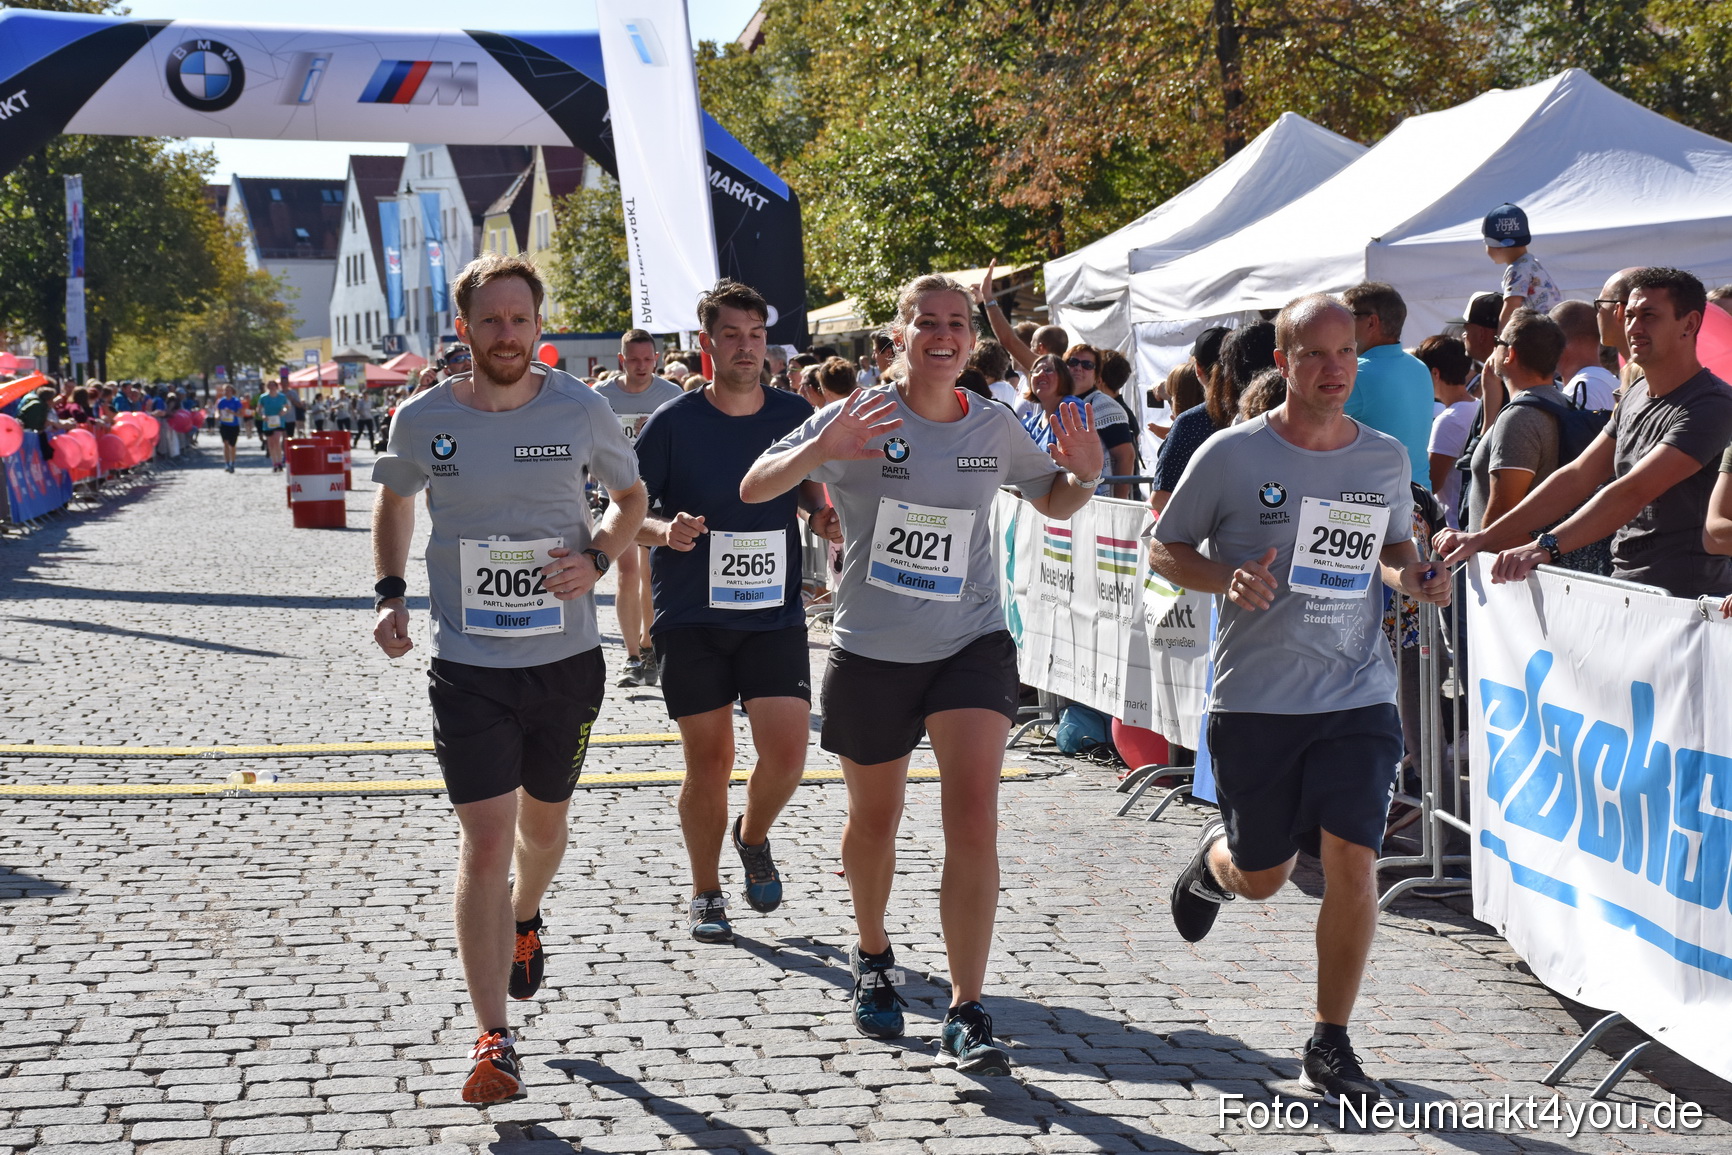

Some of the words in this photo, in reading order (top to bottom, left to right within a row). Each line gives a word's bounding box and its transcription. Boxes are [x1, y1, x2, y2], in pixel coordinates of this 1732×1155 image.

[172, 39, 238, 63] BMW
[514, 445, 571, 458] BOCK
[431, 464, 459, 472] PARTL
[957, 457, 998, 468] BOCK
[882, 465, 910, 475] PARTL
[882, 472, 910, 480] Neumarkt
[1341, 492, 1386, 505] BOCK
[906, 512, 948, 526] BOCK
[1260, 511, 1290, 520] PARTL
[1260, 518, 1290, 526] Neumarkt
[1329, 509, 1371, 524] BOCK
[732, 538, 767, 547] BOCK
[886, 527, 952, 562] 2021
[1309, 526, 1376, 560] 2996
[490, 550, 535, 560] BOCK
[721, 552, 776, 577] 2565
[890, 558, 911, 568] PARTL
[912, 563, 940, 572] Neumarkt
[1313, 558, 1334, 567] PARTL
[1334, 562, 1360, 571] Neumarkt
[476, 567, 548, 597] 2062
[897, 572, 936, 590] Karina
[1320, 573, 1355, 588] Robert
[734, 590, 764, 601] Fabian
[483, 600, 504, 608] PARTL
[495, 614, 531, 627] Oliver
